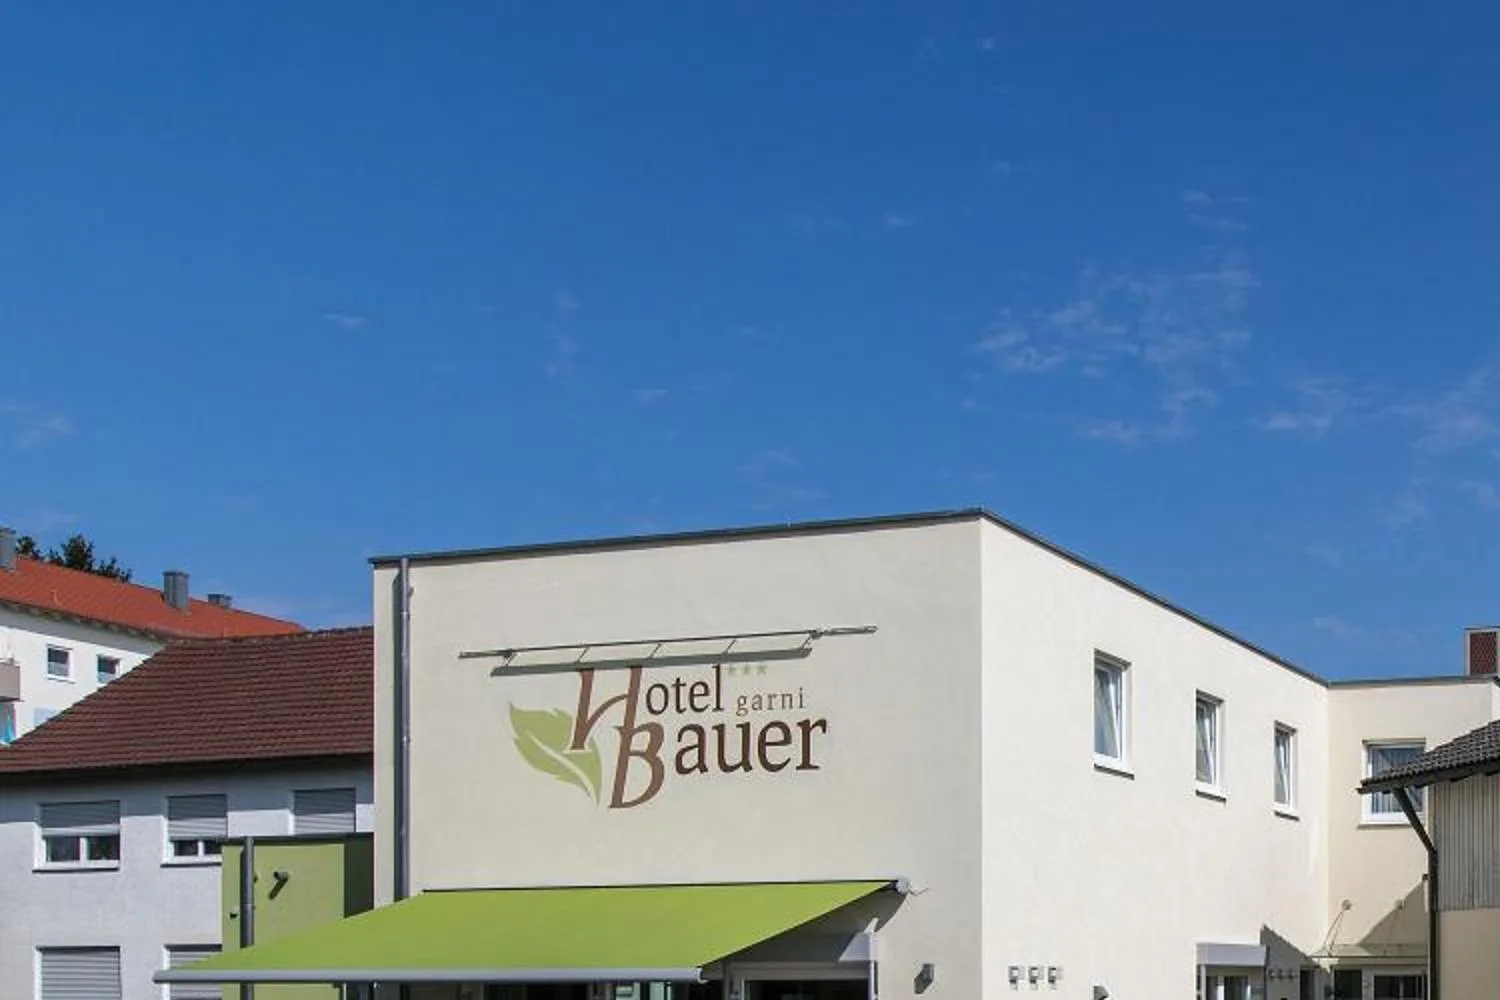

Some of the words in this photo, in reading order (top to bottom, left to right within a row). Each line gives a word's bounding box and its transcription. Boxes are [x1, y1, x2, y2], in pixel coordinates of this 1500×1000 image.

[566, 664, 723, 751] Hotel
[735, 687, 807, 716] garni
[608, 717, 828, 809] Bauer
